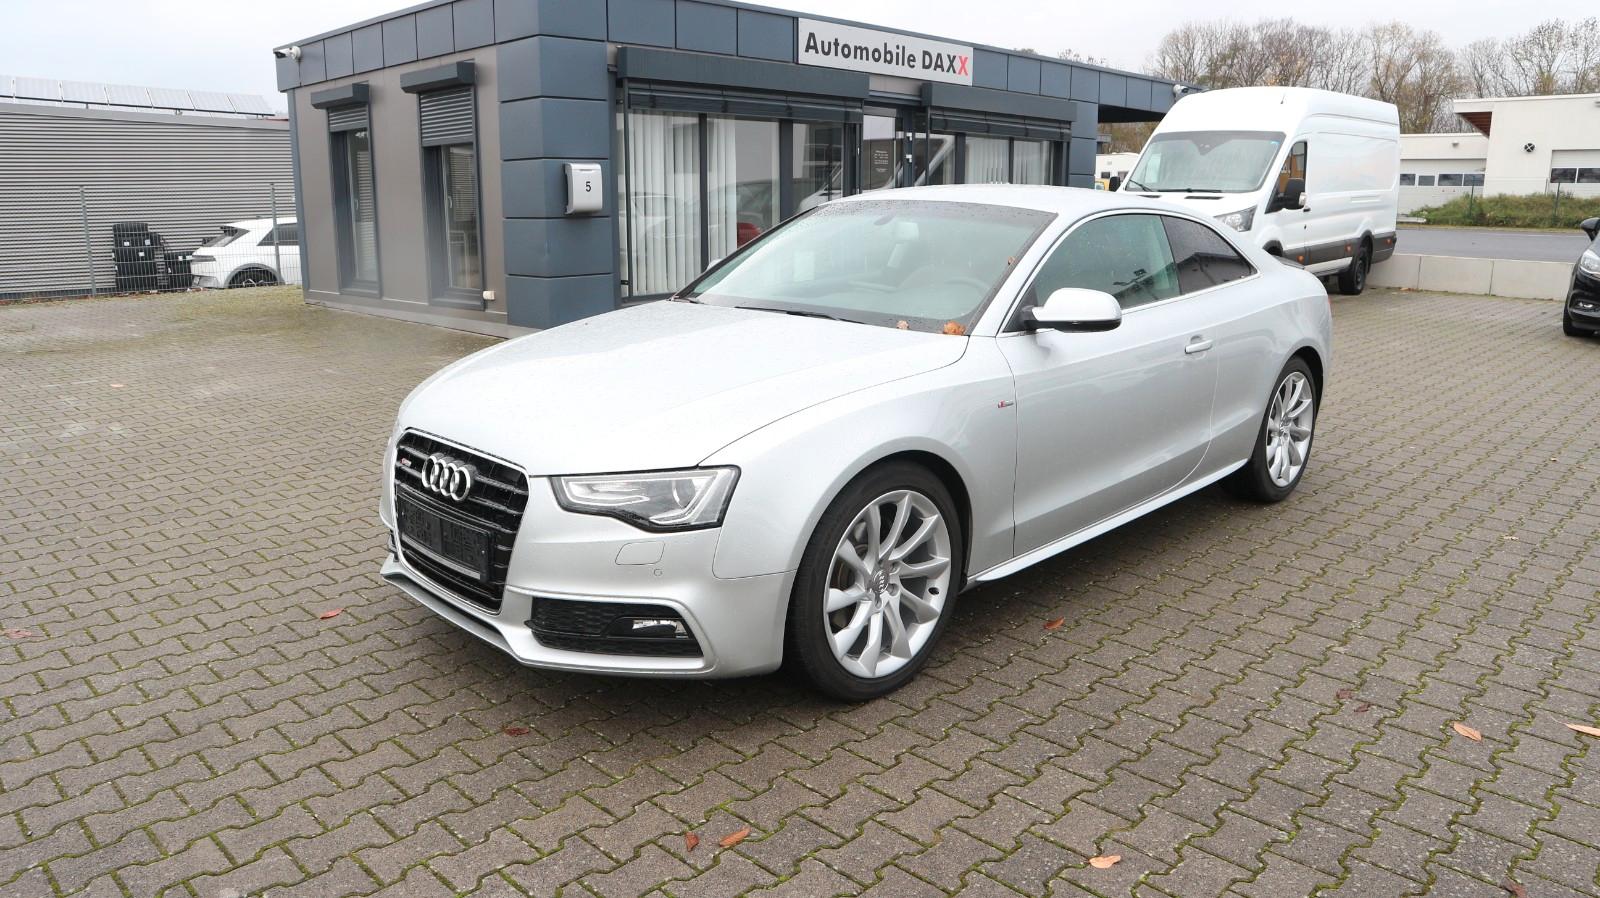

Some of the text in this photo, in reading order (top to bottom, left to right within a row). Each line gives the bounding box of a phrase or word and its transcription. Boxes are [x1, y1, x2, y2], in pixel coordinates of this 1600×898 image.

[804, 32, 969, 76] Automobile DAXX
[585, 181, 592, 193] 5
